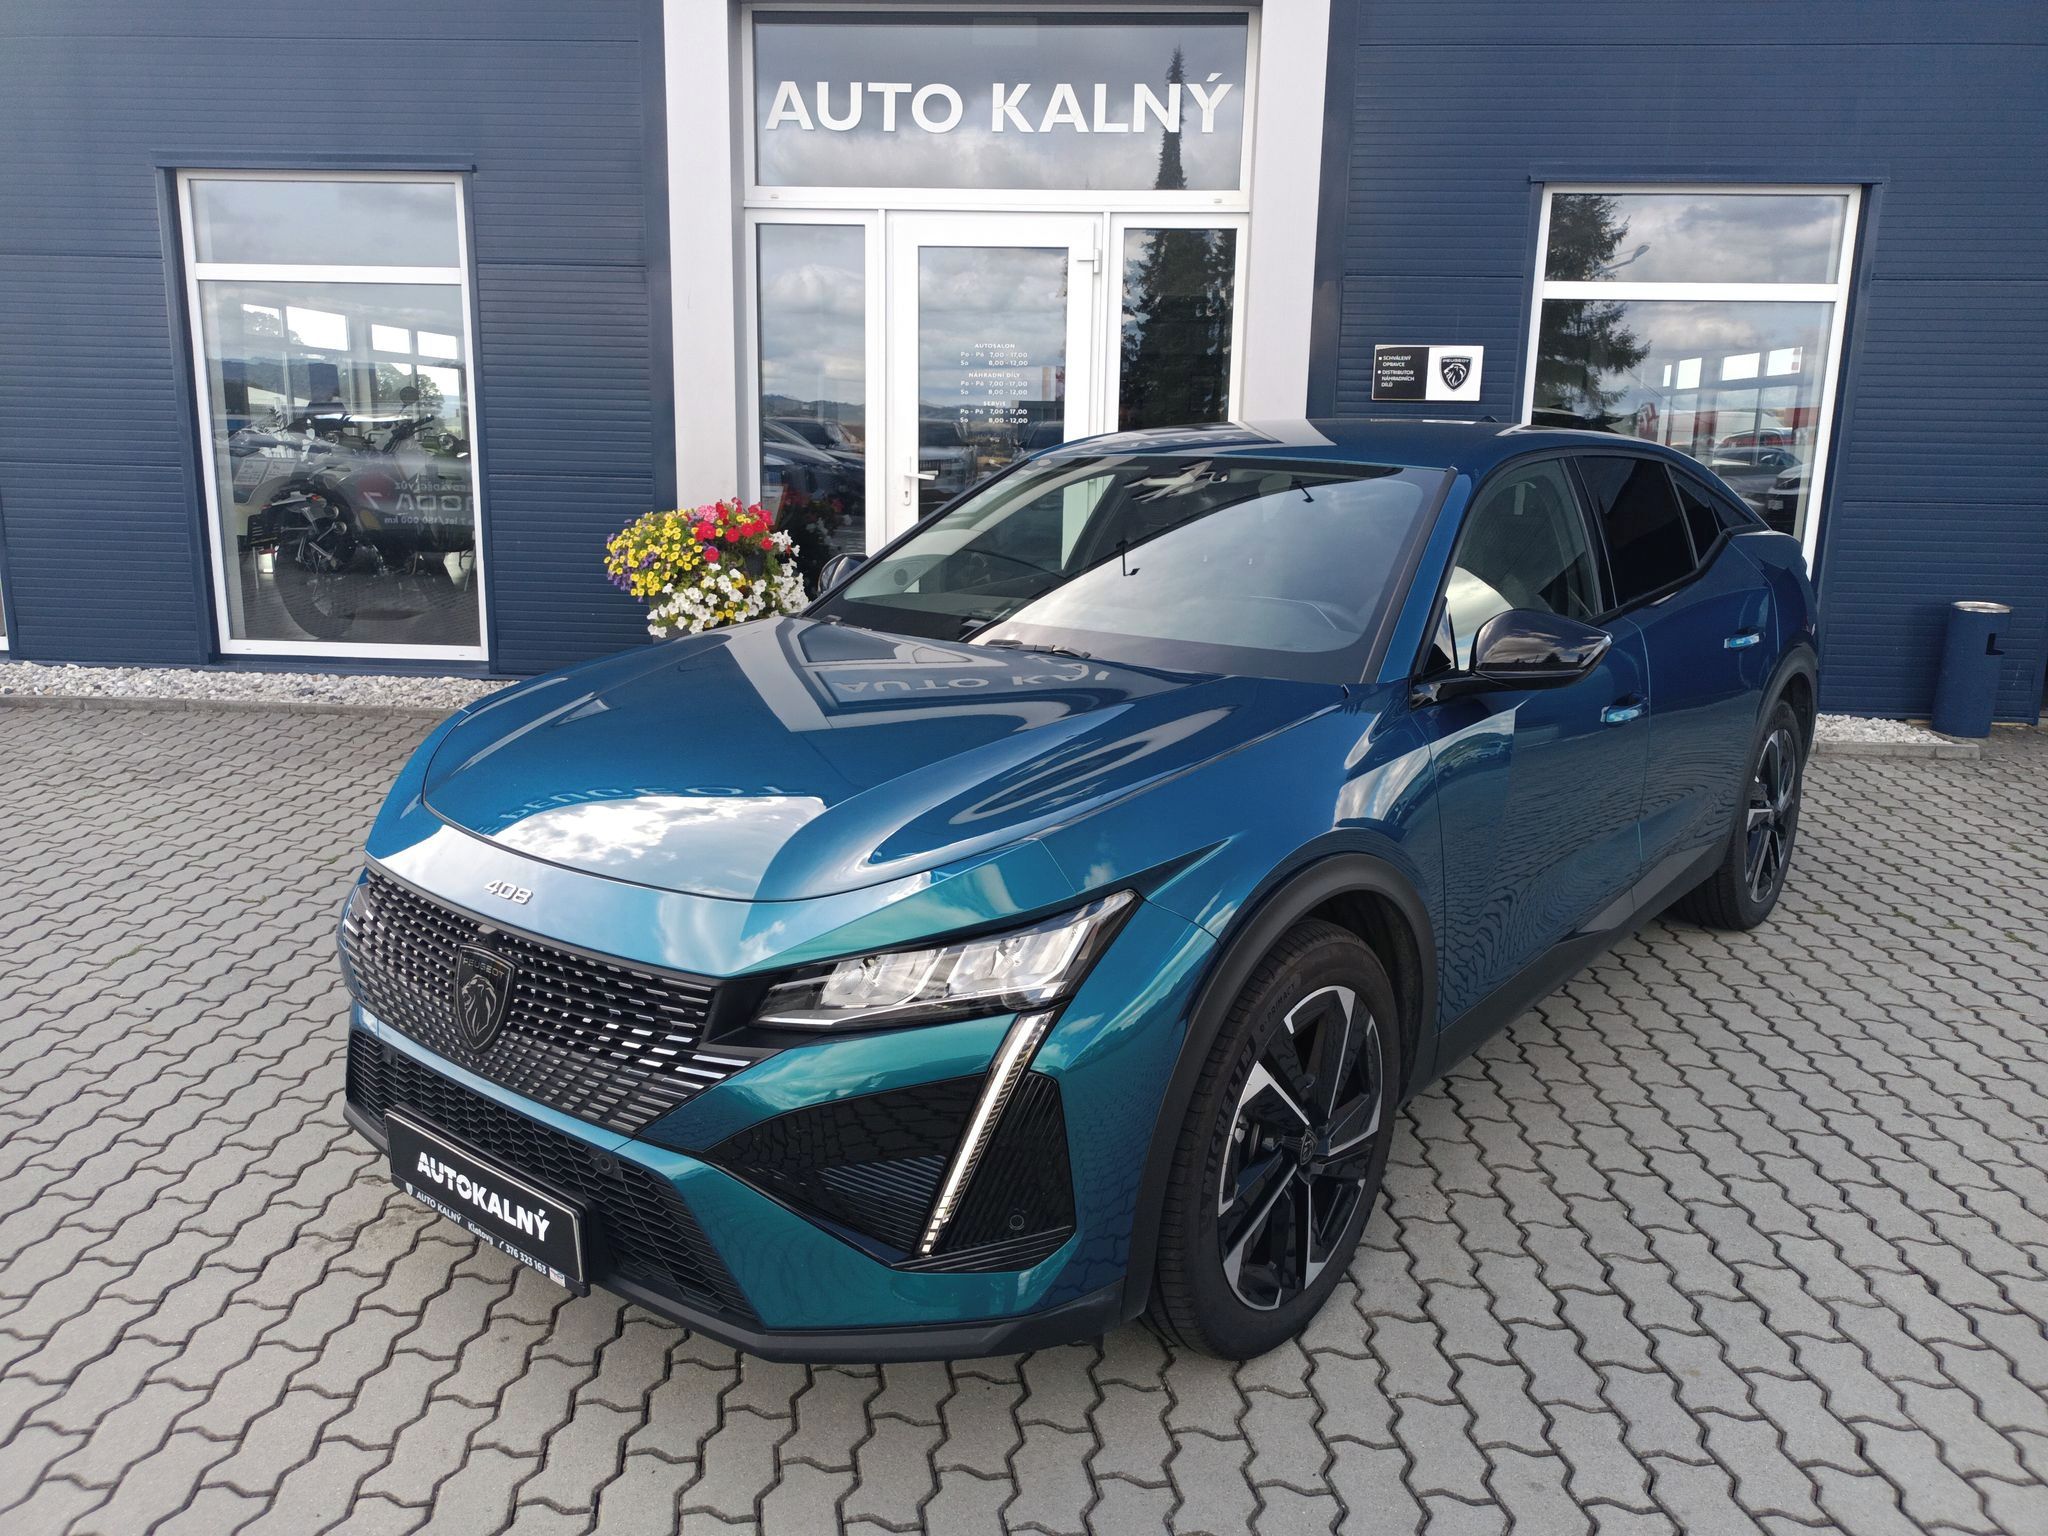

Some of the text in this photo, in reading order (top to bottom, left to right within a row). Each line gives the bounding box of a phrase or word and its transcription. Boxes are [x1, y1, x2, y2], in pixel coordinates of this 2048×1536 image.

[765, 72, 1234, 134] AUTO KALNÝ
[484, 880, 533, 904] 408
[462, 957, 505, 978] PEUGEOT
[417, 1151, 550, 1242] AUTOKALNÝ
[416, 1191, 547, 1275] AUTO KALNÝ Klatovy 376 323 163
